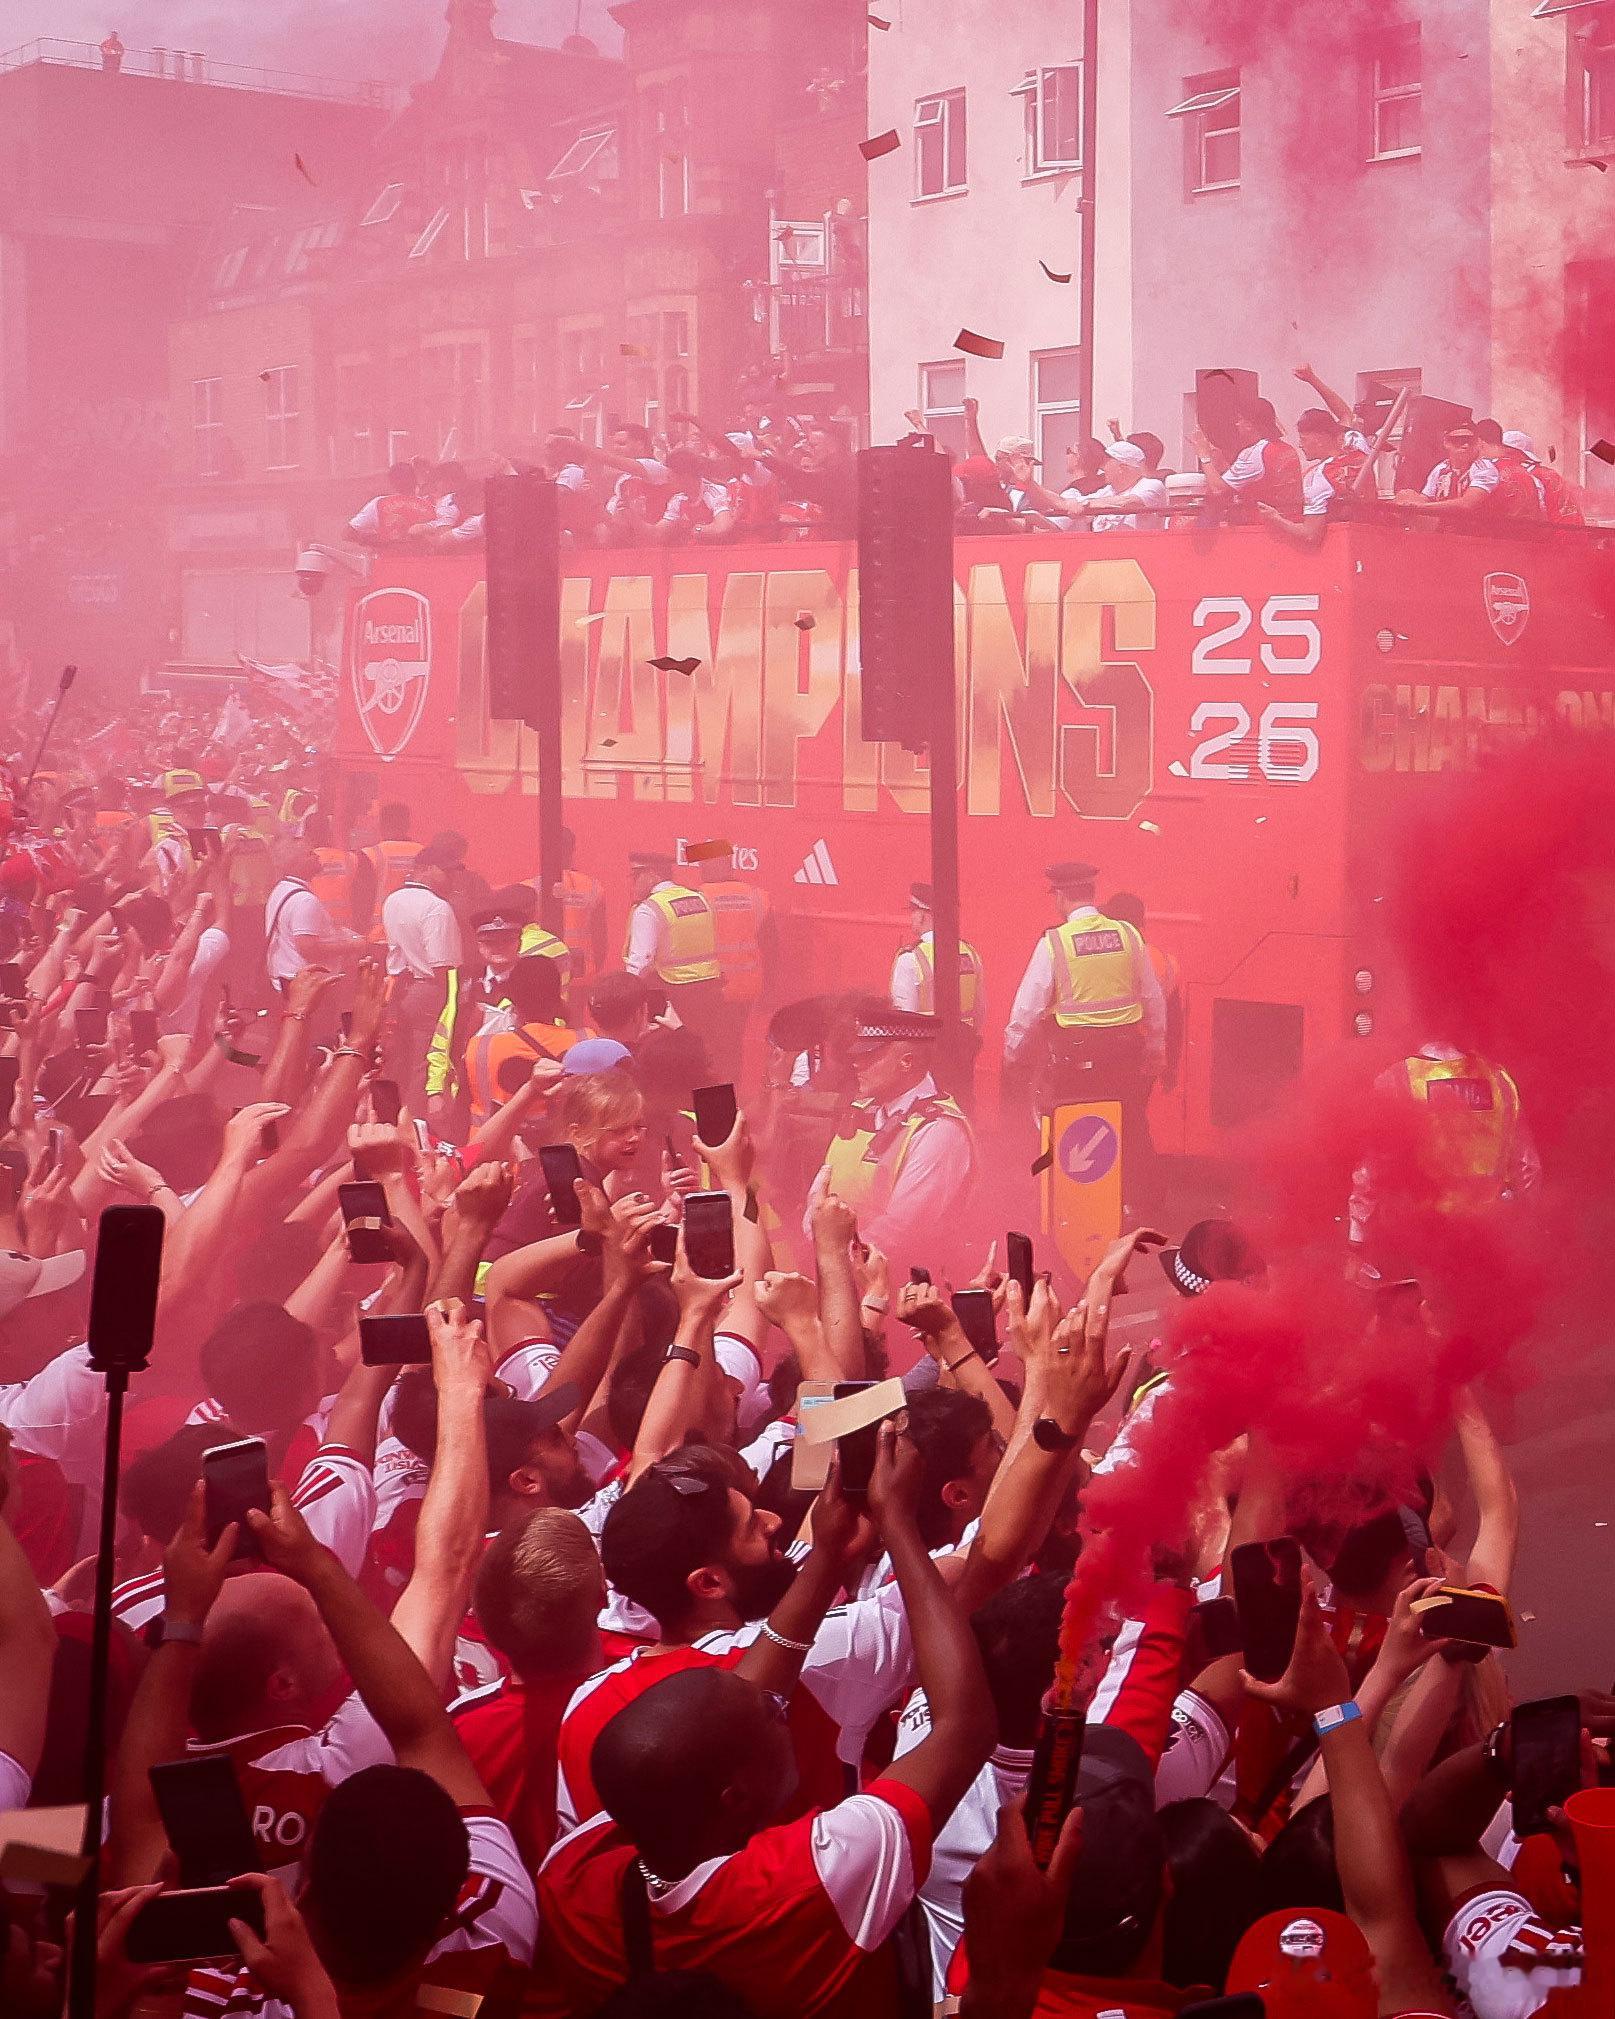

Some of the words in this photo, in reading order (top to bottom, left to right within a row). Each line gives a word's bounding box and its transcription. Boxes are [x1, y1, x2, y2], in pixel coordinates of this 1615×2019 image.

[364, 619, 420, 644] Arsenal
[1191, 594, 1322, 675] 25
[1189, 702, 1319, 782] 26
